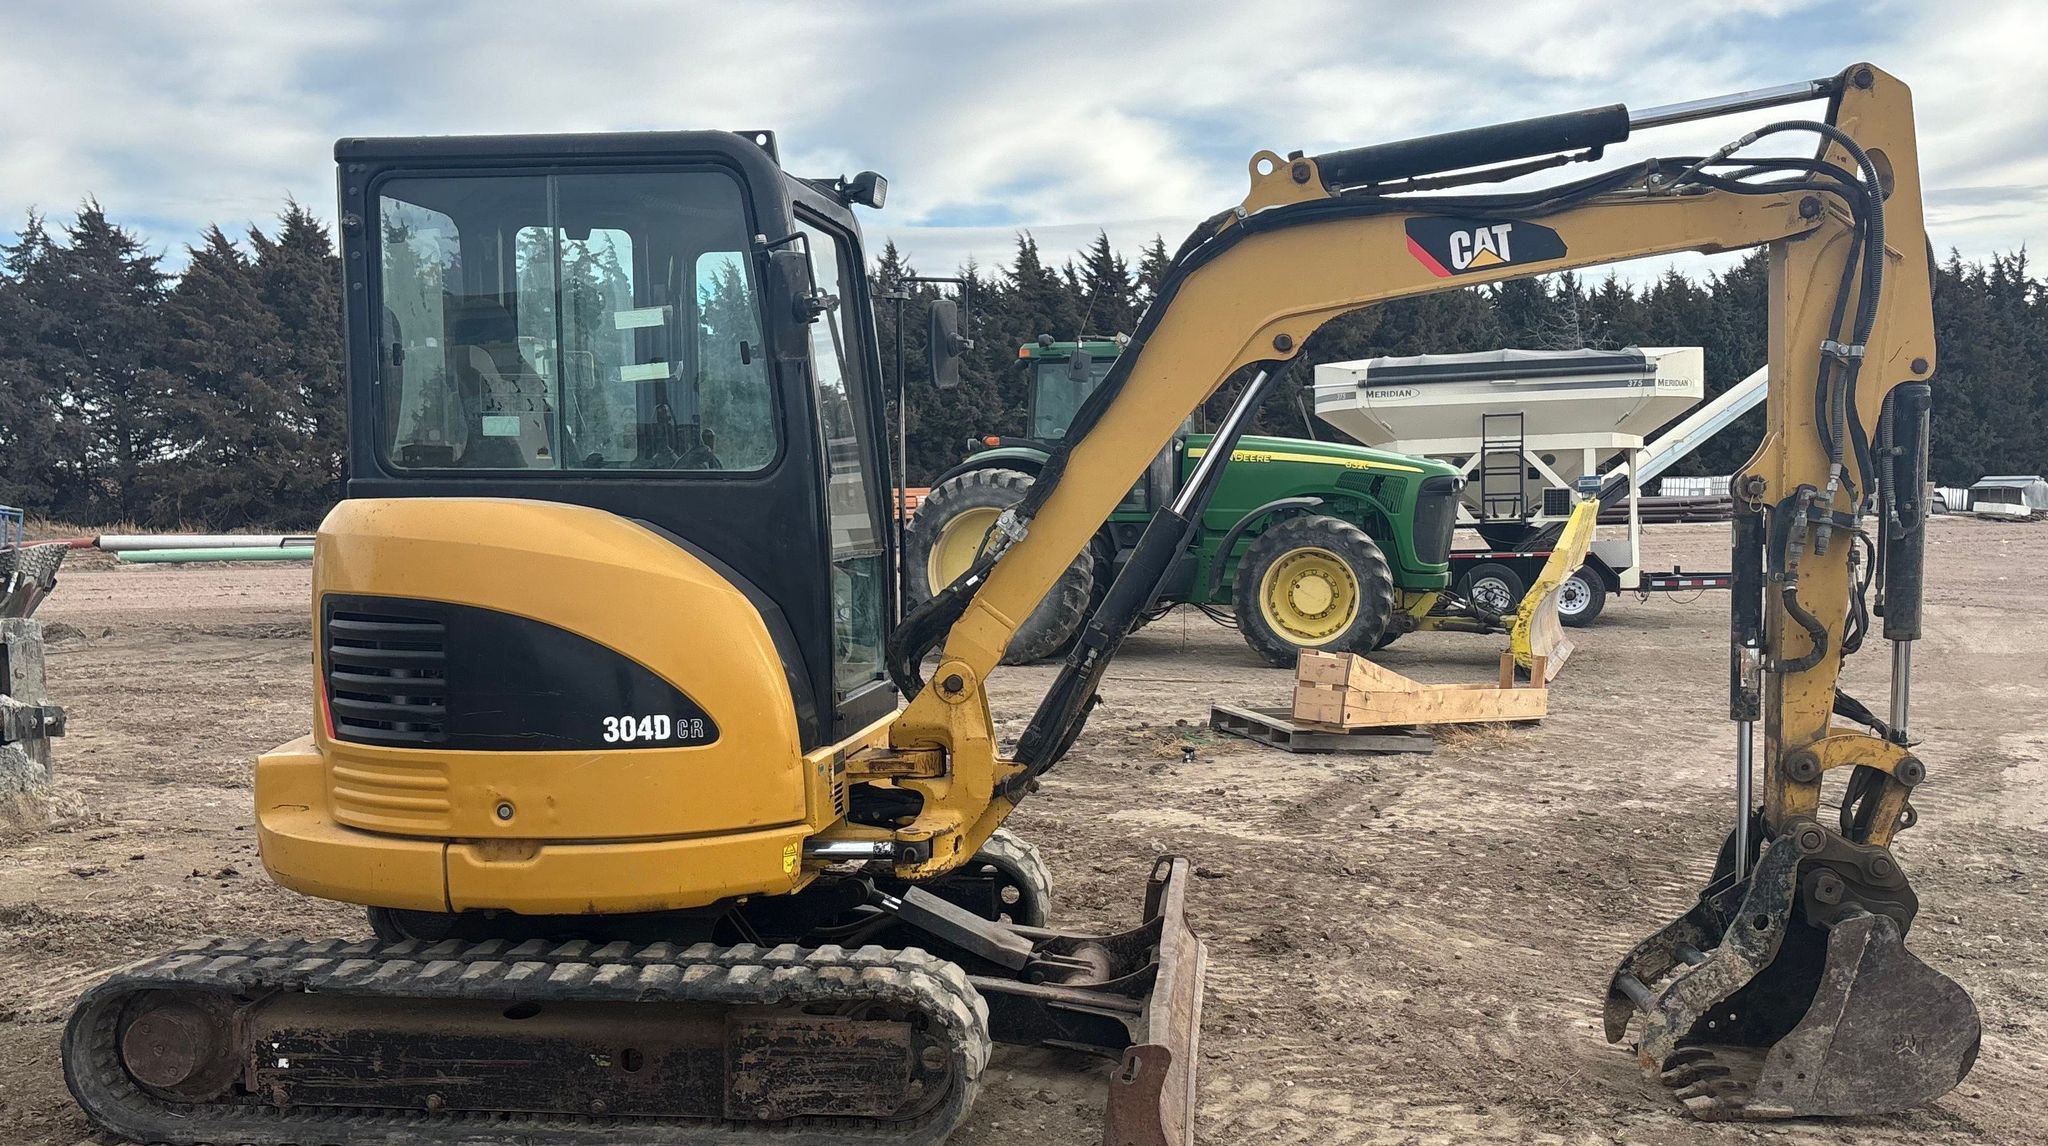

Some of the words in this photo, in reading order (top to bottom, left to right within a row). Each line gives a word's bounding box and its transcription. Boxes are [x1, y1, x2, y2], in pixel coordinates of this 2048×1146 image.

[1449, 223, 1512, 270] CAT
[1627, 379, 1643, 387] 375
[1657, 378, 1689, 387] MERIDIAN
[1365, 389, 1412, 399] MERIDIAN
[1233, 452, 1272, 463] DEERE
[602, 714, 671, 742] 304D
[677, 718, 704, 739] CR
